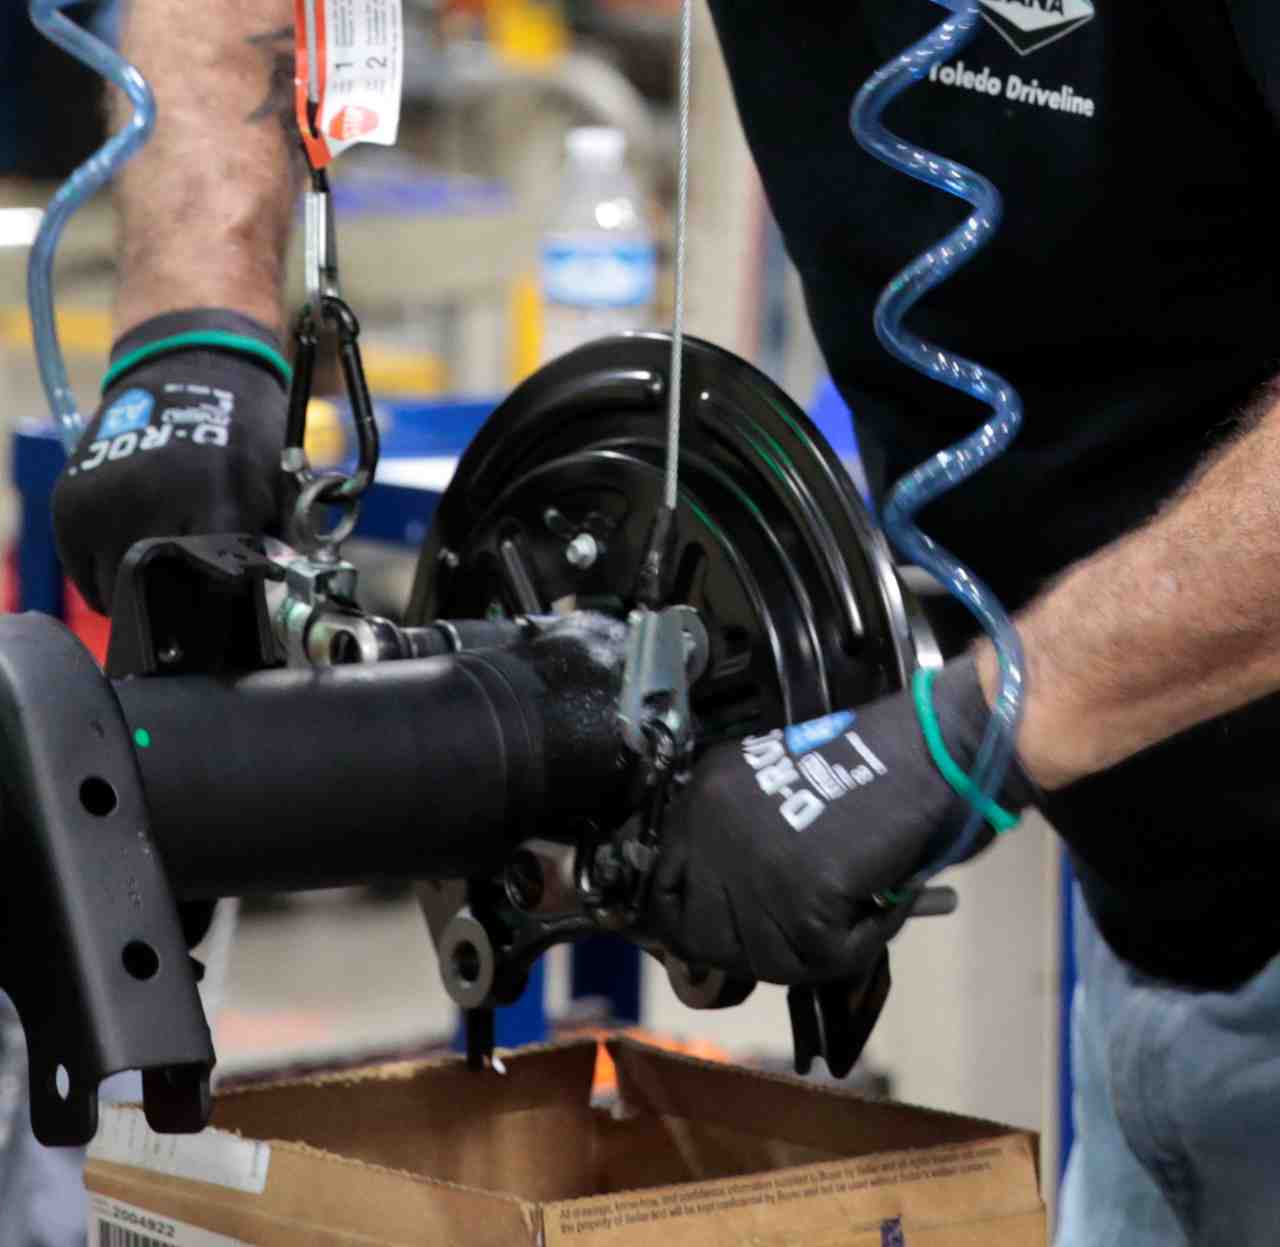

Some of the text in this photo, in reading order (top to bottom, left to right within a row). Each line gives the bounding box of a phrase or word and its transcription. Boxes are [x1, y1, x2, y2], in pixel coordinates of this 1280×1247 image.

[365, 55, 388, 70] 2
[928, 60, 1096, 118] Toledo Driveline
